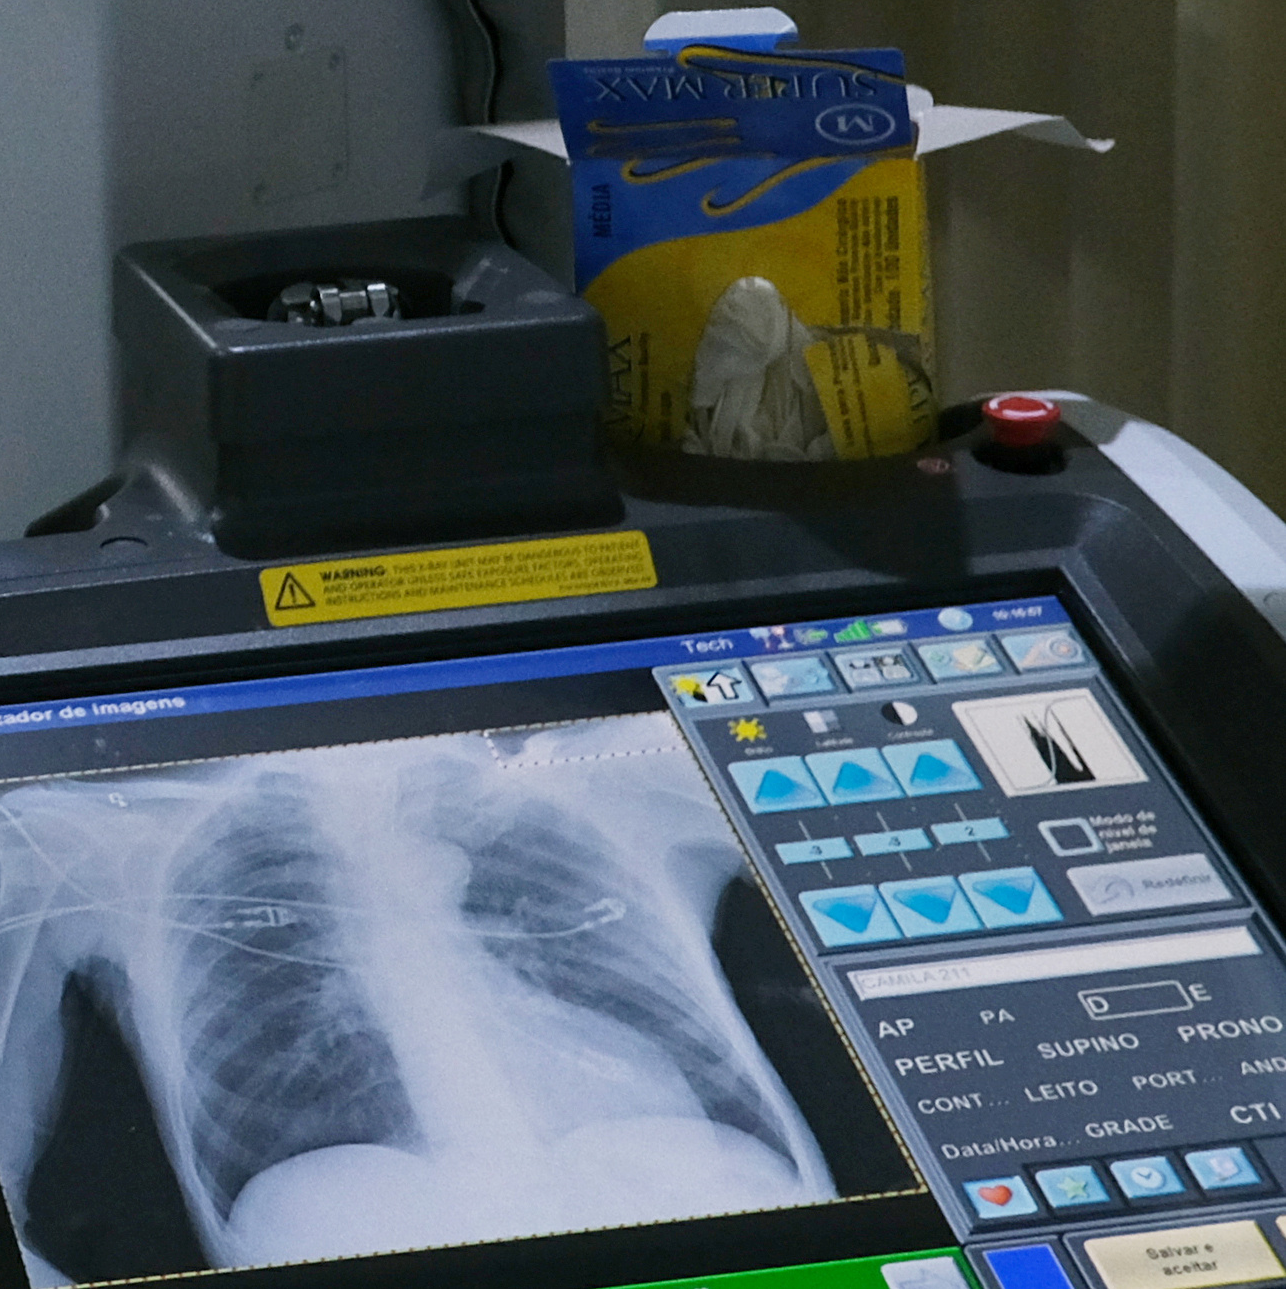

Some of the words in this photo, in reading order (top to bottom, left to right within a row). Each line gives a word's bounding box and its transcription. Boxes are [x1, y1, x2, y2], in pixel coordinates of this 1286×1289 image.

[592, 74, 705, 102] MAX
[588, 183, 613, 238] MÉDIA
[680, 636, 734, 655] Tech
[58, 704, 87, 720] de
[91, 696, 187, 716] imagens
[861, 970, 937, 990] CAMILA
[877, 1017, 915, 1039] AP
[979, 1008, 1016, 1025] PA
[1086, 995, 1109, 1013] D
[1188, 982, 1212, 1002] E
[894, 1048, 1005, 1077] PERFIL
[1037, 1032, 1139, 1060] SUPINO
[1176, 1015, 1284, 1043] PRONO
[1024, 1079, 1099, 1103] LEITO
[1084, 1113, 1174, 1139] GRADE
[1229, 1101, 1282, 1124] CTI
[1145, 1244, 1199, 1260] Salvar
[1203, 1243, 1214, 1253] e
[1162, 1260, 1219, 1276] aceitar
